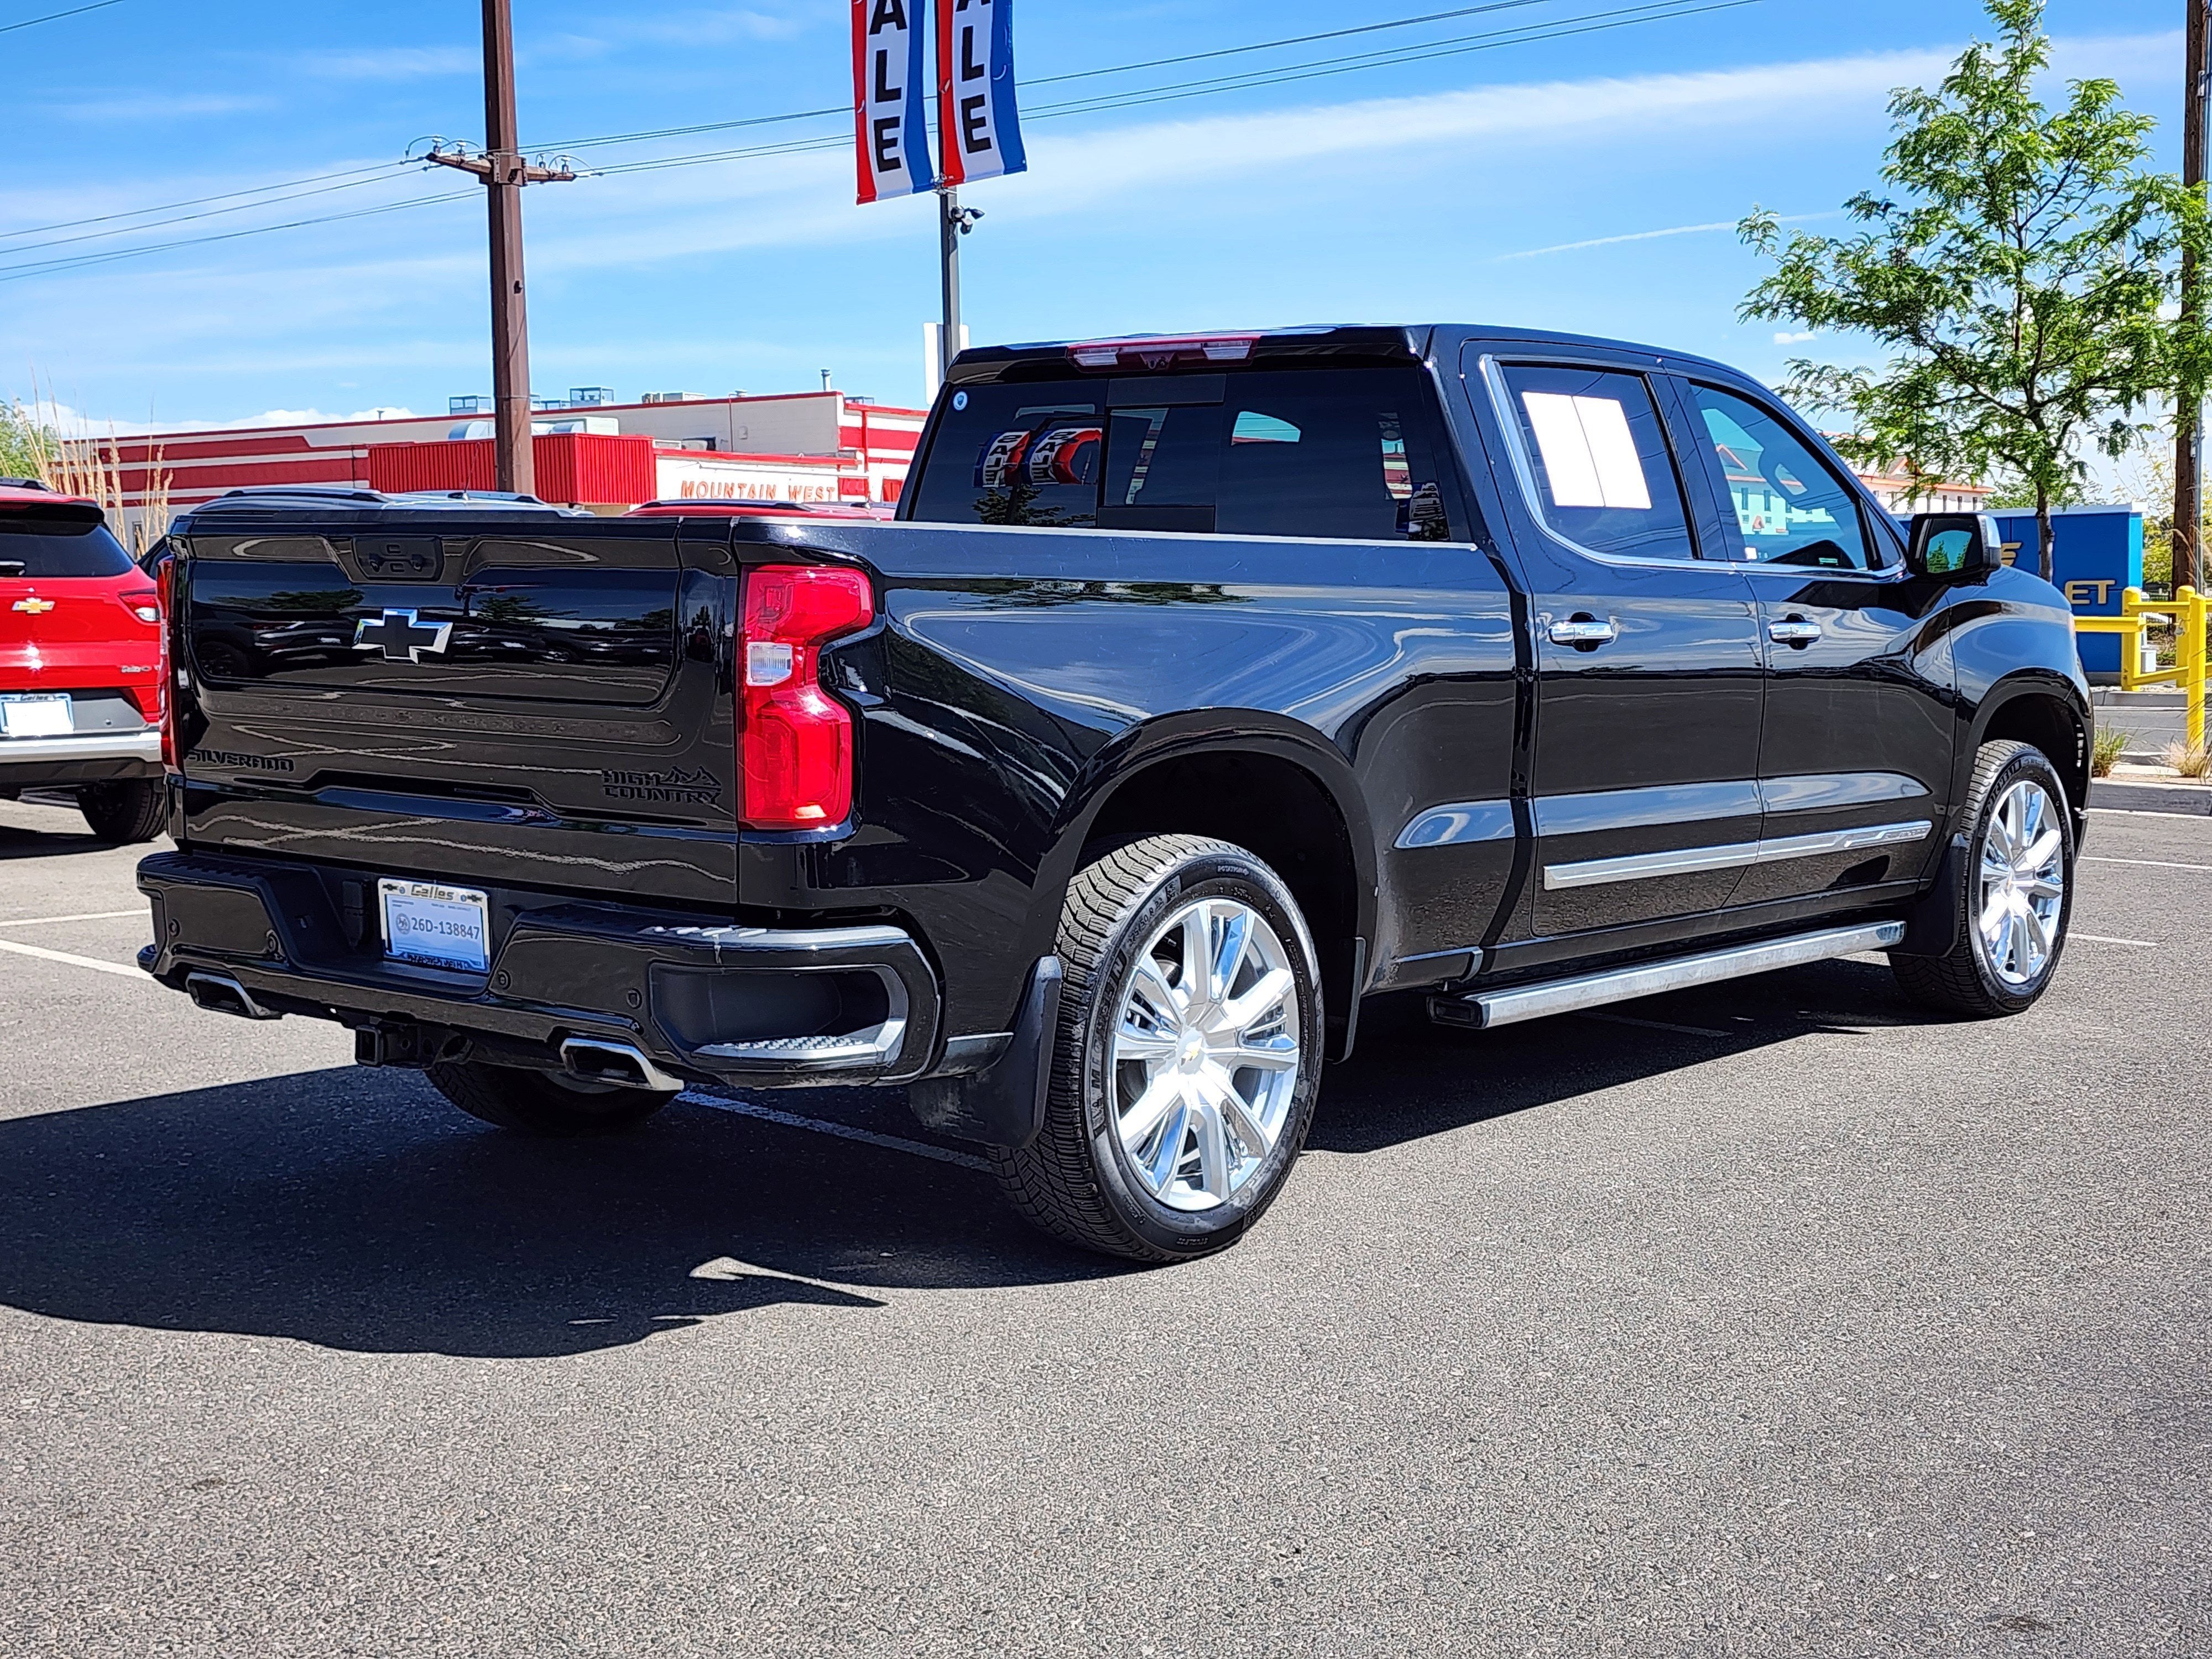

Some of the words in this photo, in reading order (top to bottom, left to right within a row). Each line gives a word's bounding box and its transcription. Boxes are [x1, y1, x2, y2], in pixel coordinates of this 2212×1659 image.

[956, 0, 992, 154] LE
[681, 481, 776, 500] MOUNTAIN
[789, 484, 835, 502] WEST
[2065, 580, 2115, 604] ET
[186, 750, 295, 772] SILVERADO
[602, 769, 661, 786] HIGH
[1987, 761, 2020, 811] MICHELIN
[603, 784, 722, 804] COUNTRY
[411, 884, 454, 900] Galles
[411, 917, 480, 940] 26D-138847
